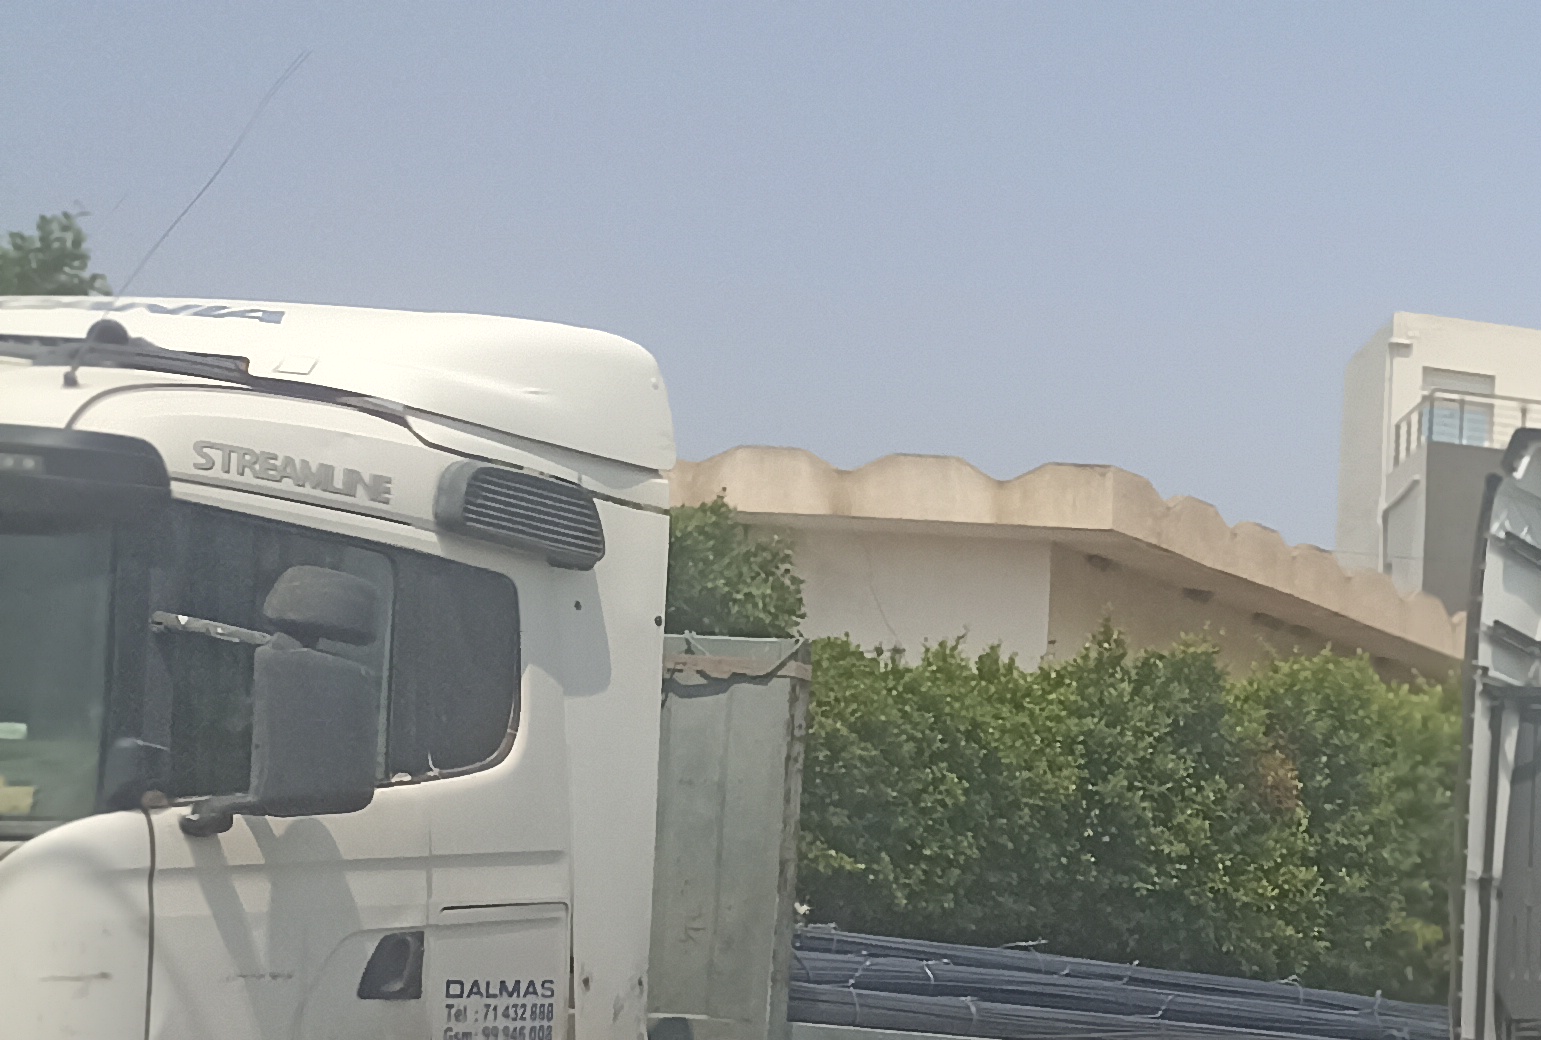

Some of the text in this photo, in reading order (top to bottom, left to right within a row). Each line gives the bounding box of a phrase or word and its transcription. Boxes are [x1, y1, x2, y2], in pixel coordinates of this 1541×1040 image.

[193, 440, 392, 504] STREAMLINE
[445, 979, 555, 998] DALMAS
[483, 1003, 498, 1022] 71
[501, 1003, 527, 1021] 432
